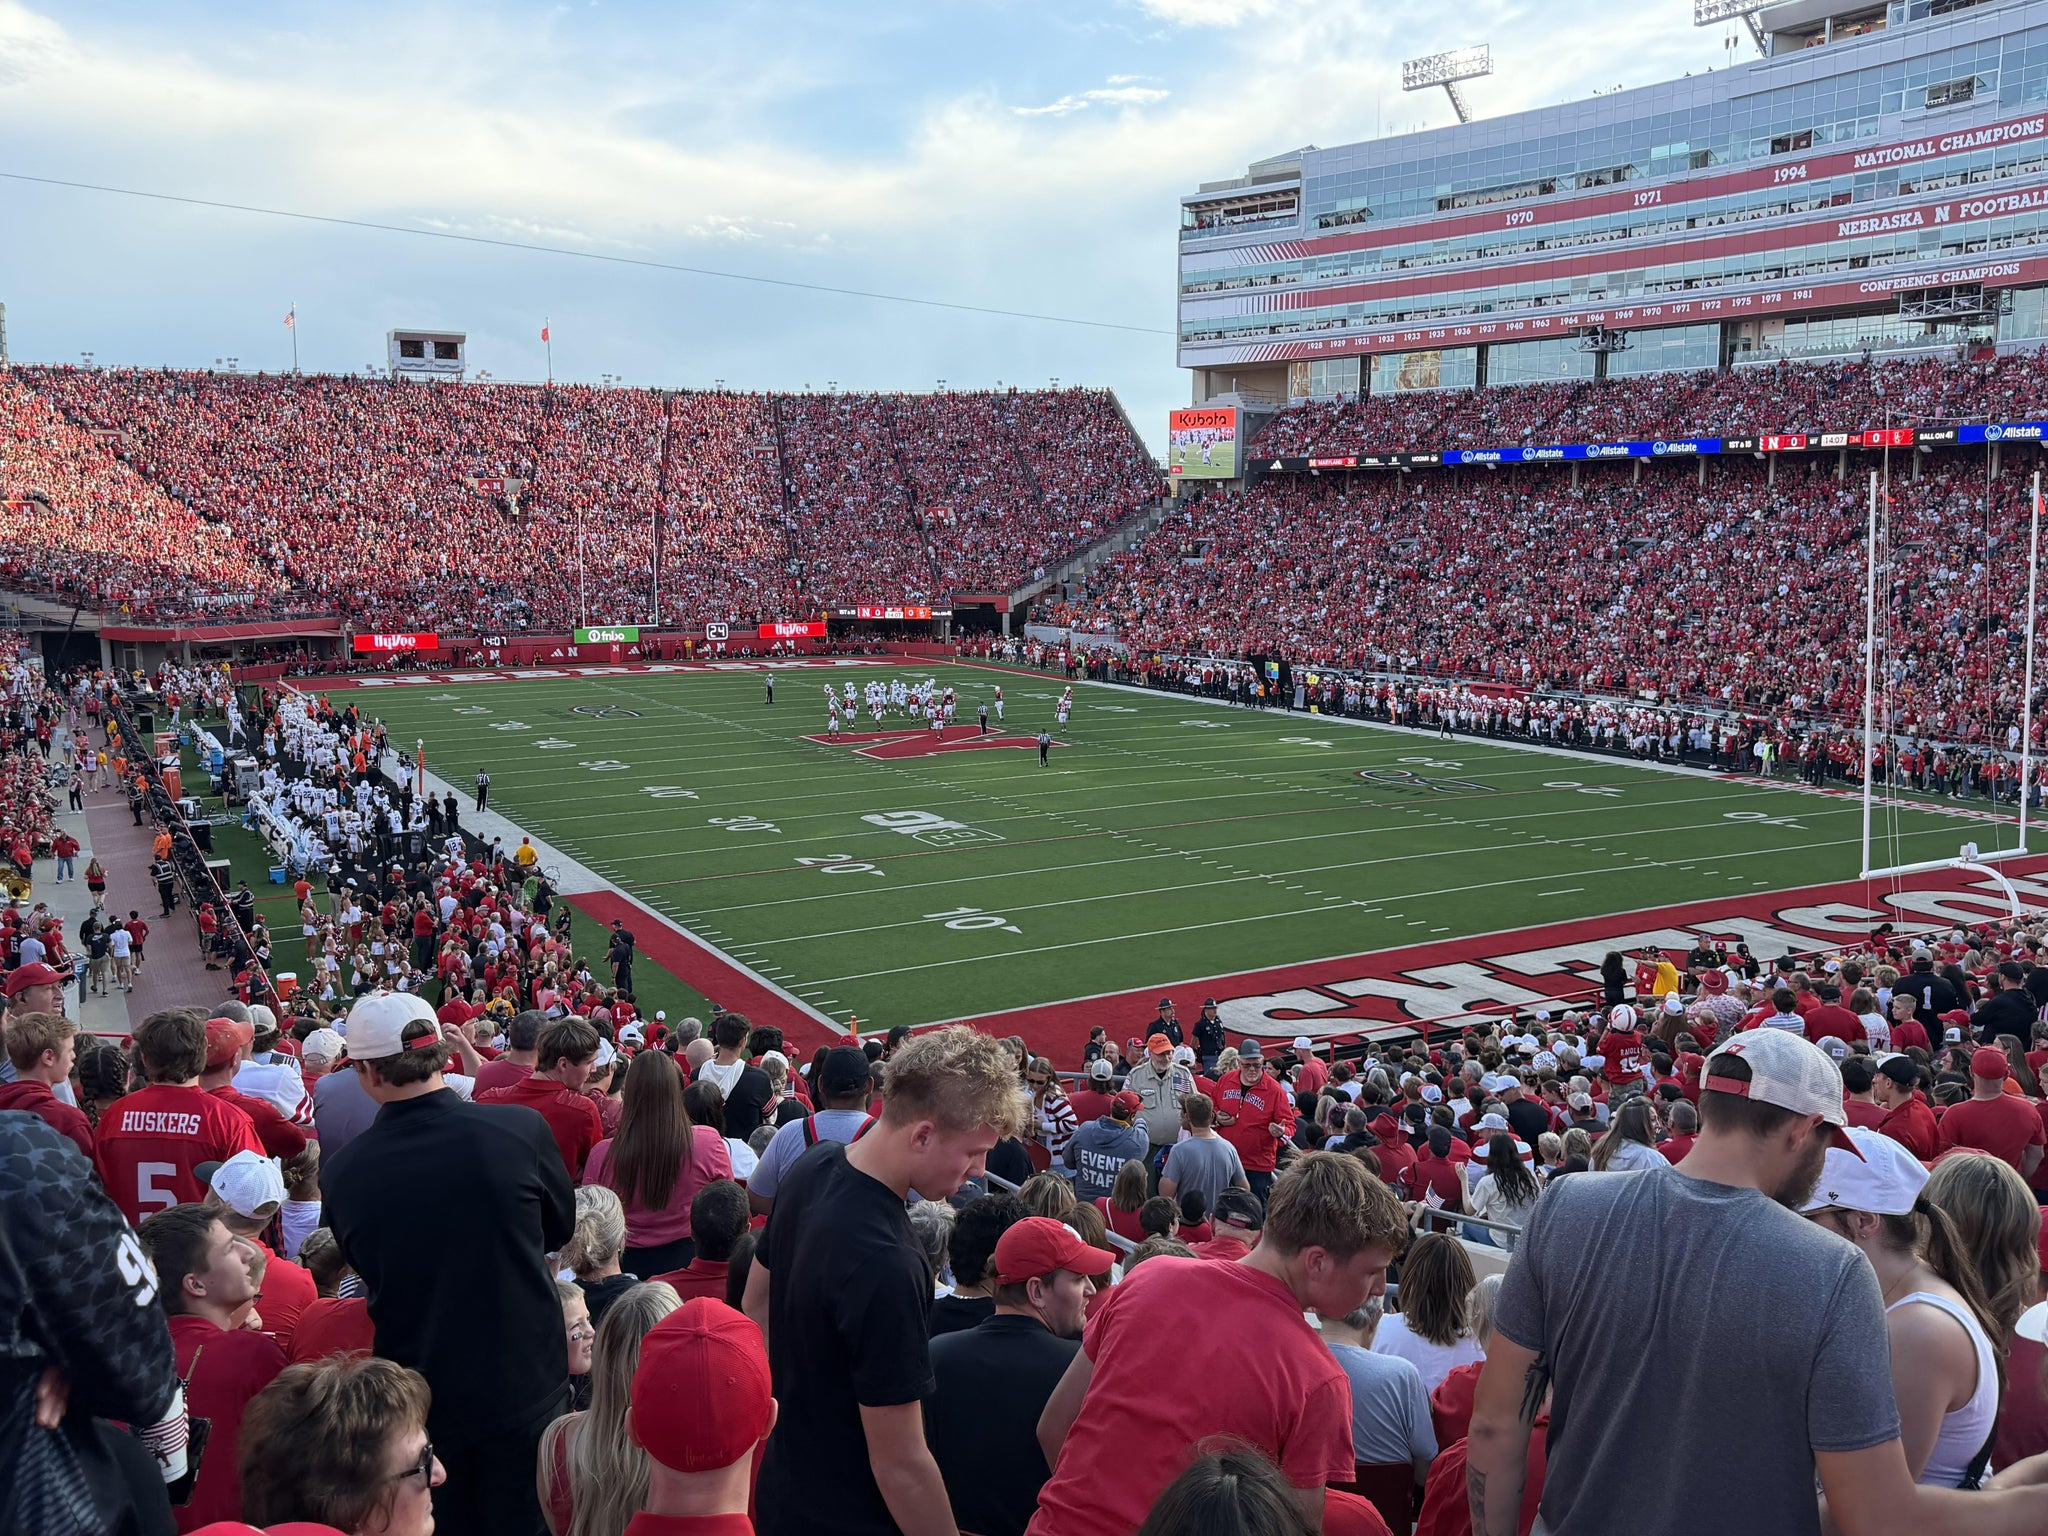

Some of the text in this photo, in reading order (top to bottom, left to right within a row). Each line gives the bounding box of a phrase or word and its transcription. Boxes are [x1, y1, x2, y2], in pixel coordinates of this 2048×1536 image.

[1853, 118, 2045, 168] NATIONAL CHAMPIONS
[1773, 164, 1807, 183] 1994
[1633, 190, 1662, 206] 1971
[1505, 210, 1534, 226] 1970
[1838, 211, 1924, 237] NEBRASKA
[1934, 205, 1950, 223] N
[1859, 262, 2020, 293] CONFERENCE CHAMPIONS
[1307, 290, 1813, 350] 1928 1929 1931 1932 1933 1935 1936 1937 1940 1963 1964 1966 1969 1970 1971 1972 1975 1978 1981
[1180, 411, 1227, 427] Kubota
[1872, 432, 1880, 443] 0
[1919, 432, 1934, 441] BALL
[1934, 432, 1944, 440] ON
[2002, 426, 2041, 438] Allstate
[1768, 436, 1779, 449] N
[1790, 436, 1798, 447] 0
[1825, 436, 1844, 444] 14:07
[1535, 448, 1564, 459] Allstate
[1599, 446, 1629, 456] Allstate
[1666, 442, 1697, 453] Allstate
[1473, 451, 1500, 462] Allstate
[862, 608, 871, 616] N
[601, 631, 625, 641] fnbo
[709, 625, 725, 638] 24
[775, 624, 808, 637] HyVee
[373, 634, 416, 650] HyVee
[482, 636, 507, 646] 14:07
[567, 646, 578, 657] N
[350, 658, 897, 687] NEBRASKA
[302, 790, 312, 799] 22
[639, 785, 696, 799] 40
[708, 814, 769, 833] 30
[1722, 811, 1799, 825] 10
[448, 842, 458, 852] 12
[794, 853, 876, 875] 20
[922, 906, 1007, 930] 10
[1921, 985, 1932, 1010] 1
[1619, 1056, 1641, 1074] 15
[121, 1110, 202, 1136] HUSKERS
[1080, 1149, 1126, 1172] EVENT
[1081, 1167, 1116, 1189] STAF
[137, 1161, 178, 1229] 5
